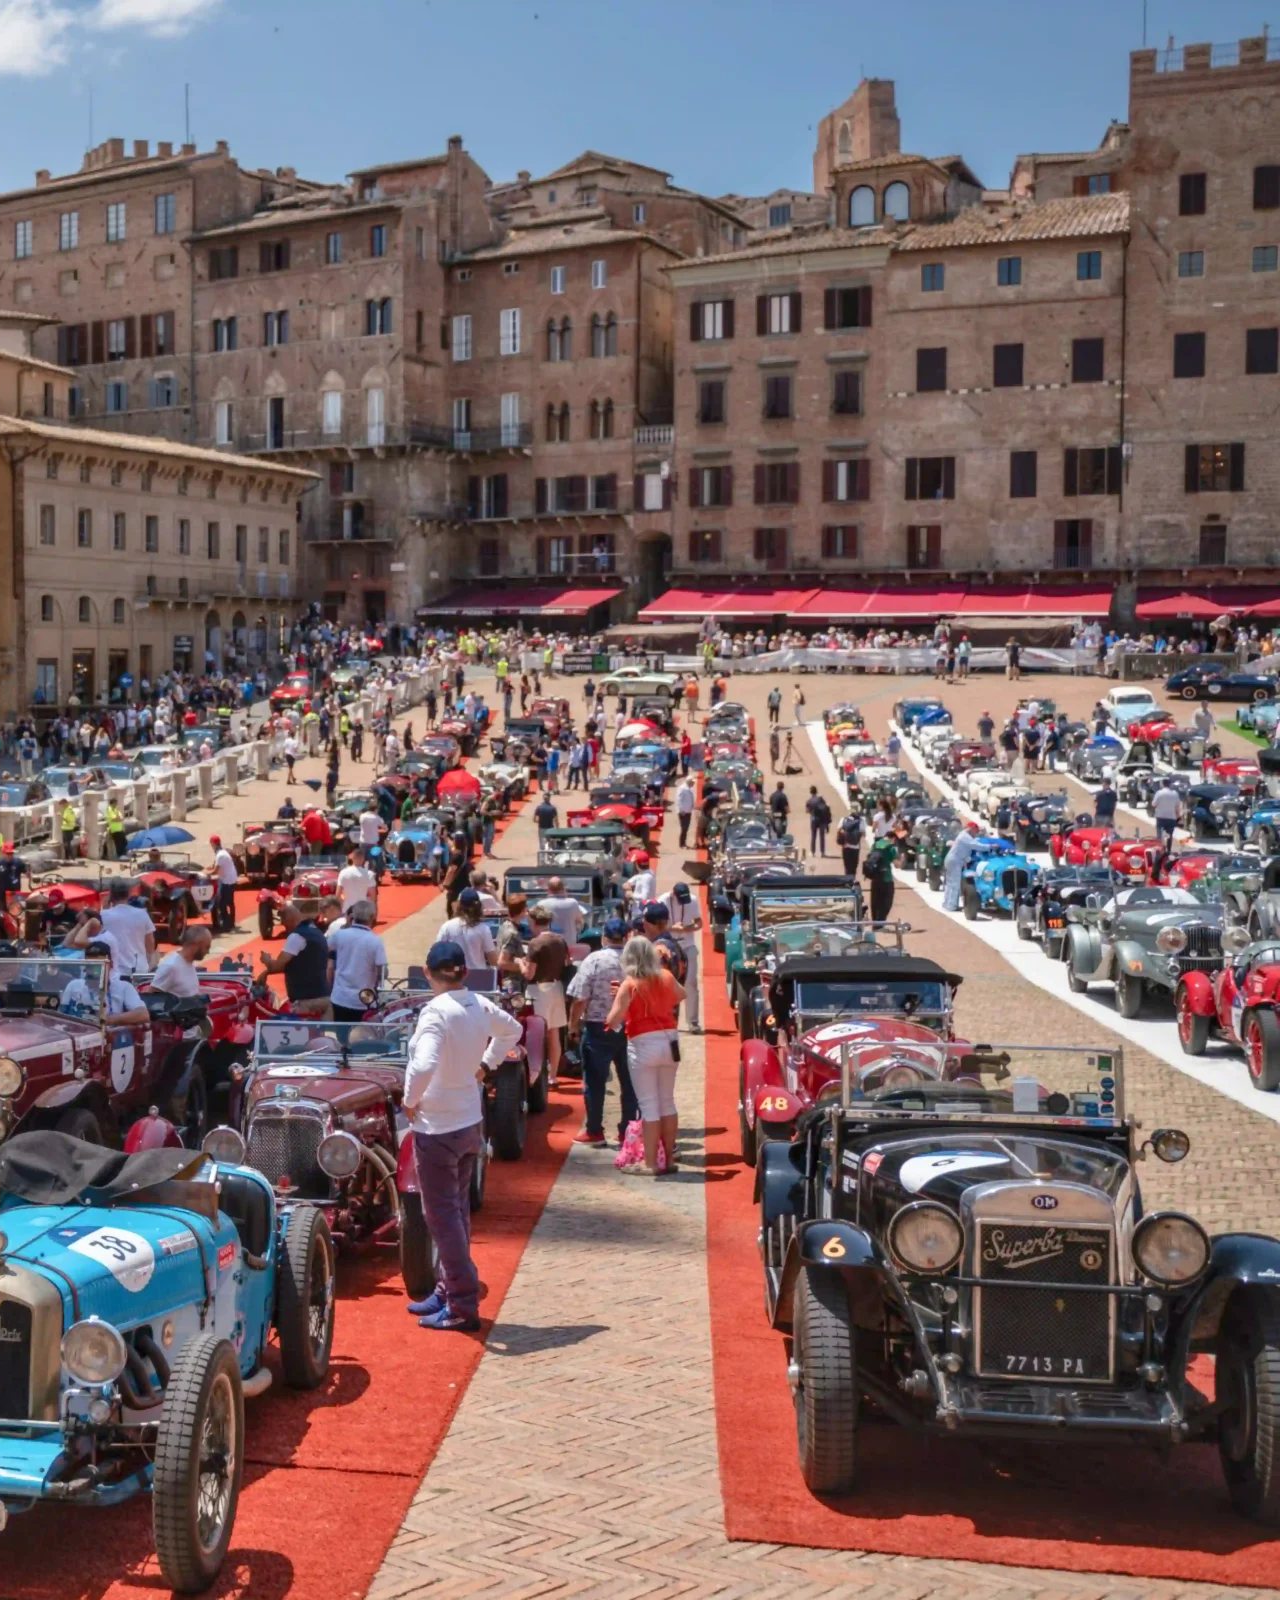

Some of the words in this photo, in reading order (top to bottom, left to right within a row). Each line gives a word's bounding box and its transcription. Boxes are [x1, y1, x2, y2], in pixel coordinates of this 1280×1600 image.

[280, 1031, 291, 1046] 3
[760, 1097, 788, 1111] 48
[1034, 1197, 1055, 1207] OM
[89, 1235, 137, 1261] 38
[823, 1237, 846, 1257] 6
[983, 1228, 1064, 1264] Superba
[1006, 1355, 1053, 1373] 7713
[1063, 1358, 1084, 1374] PA
